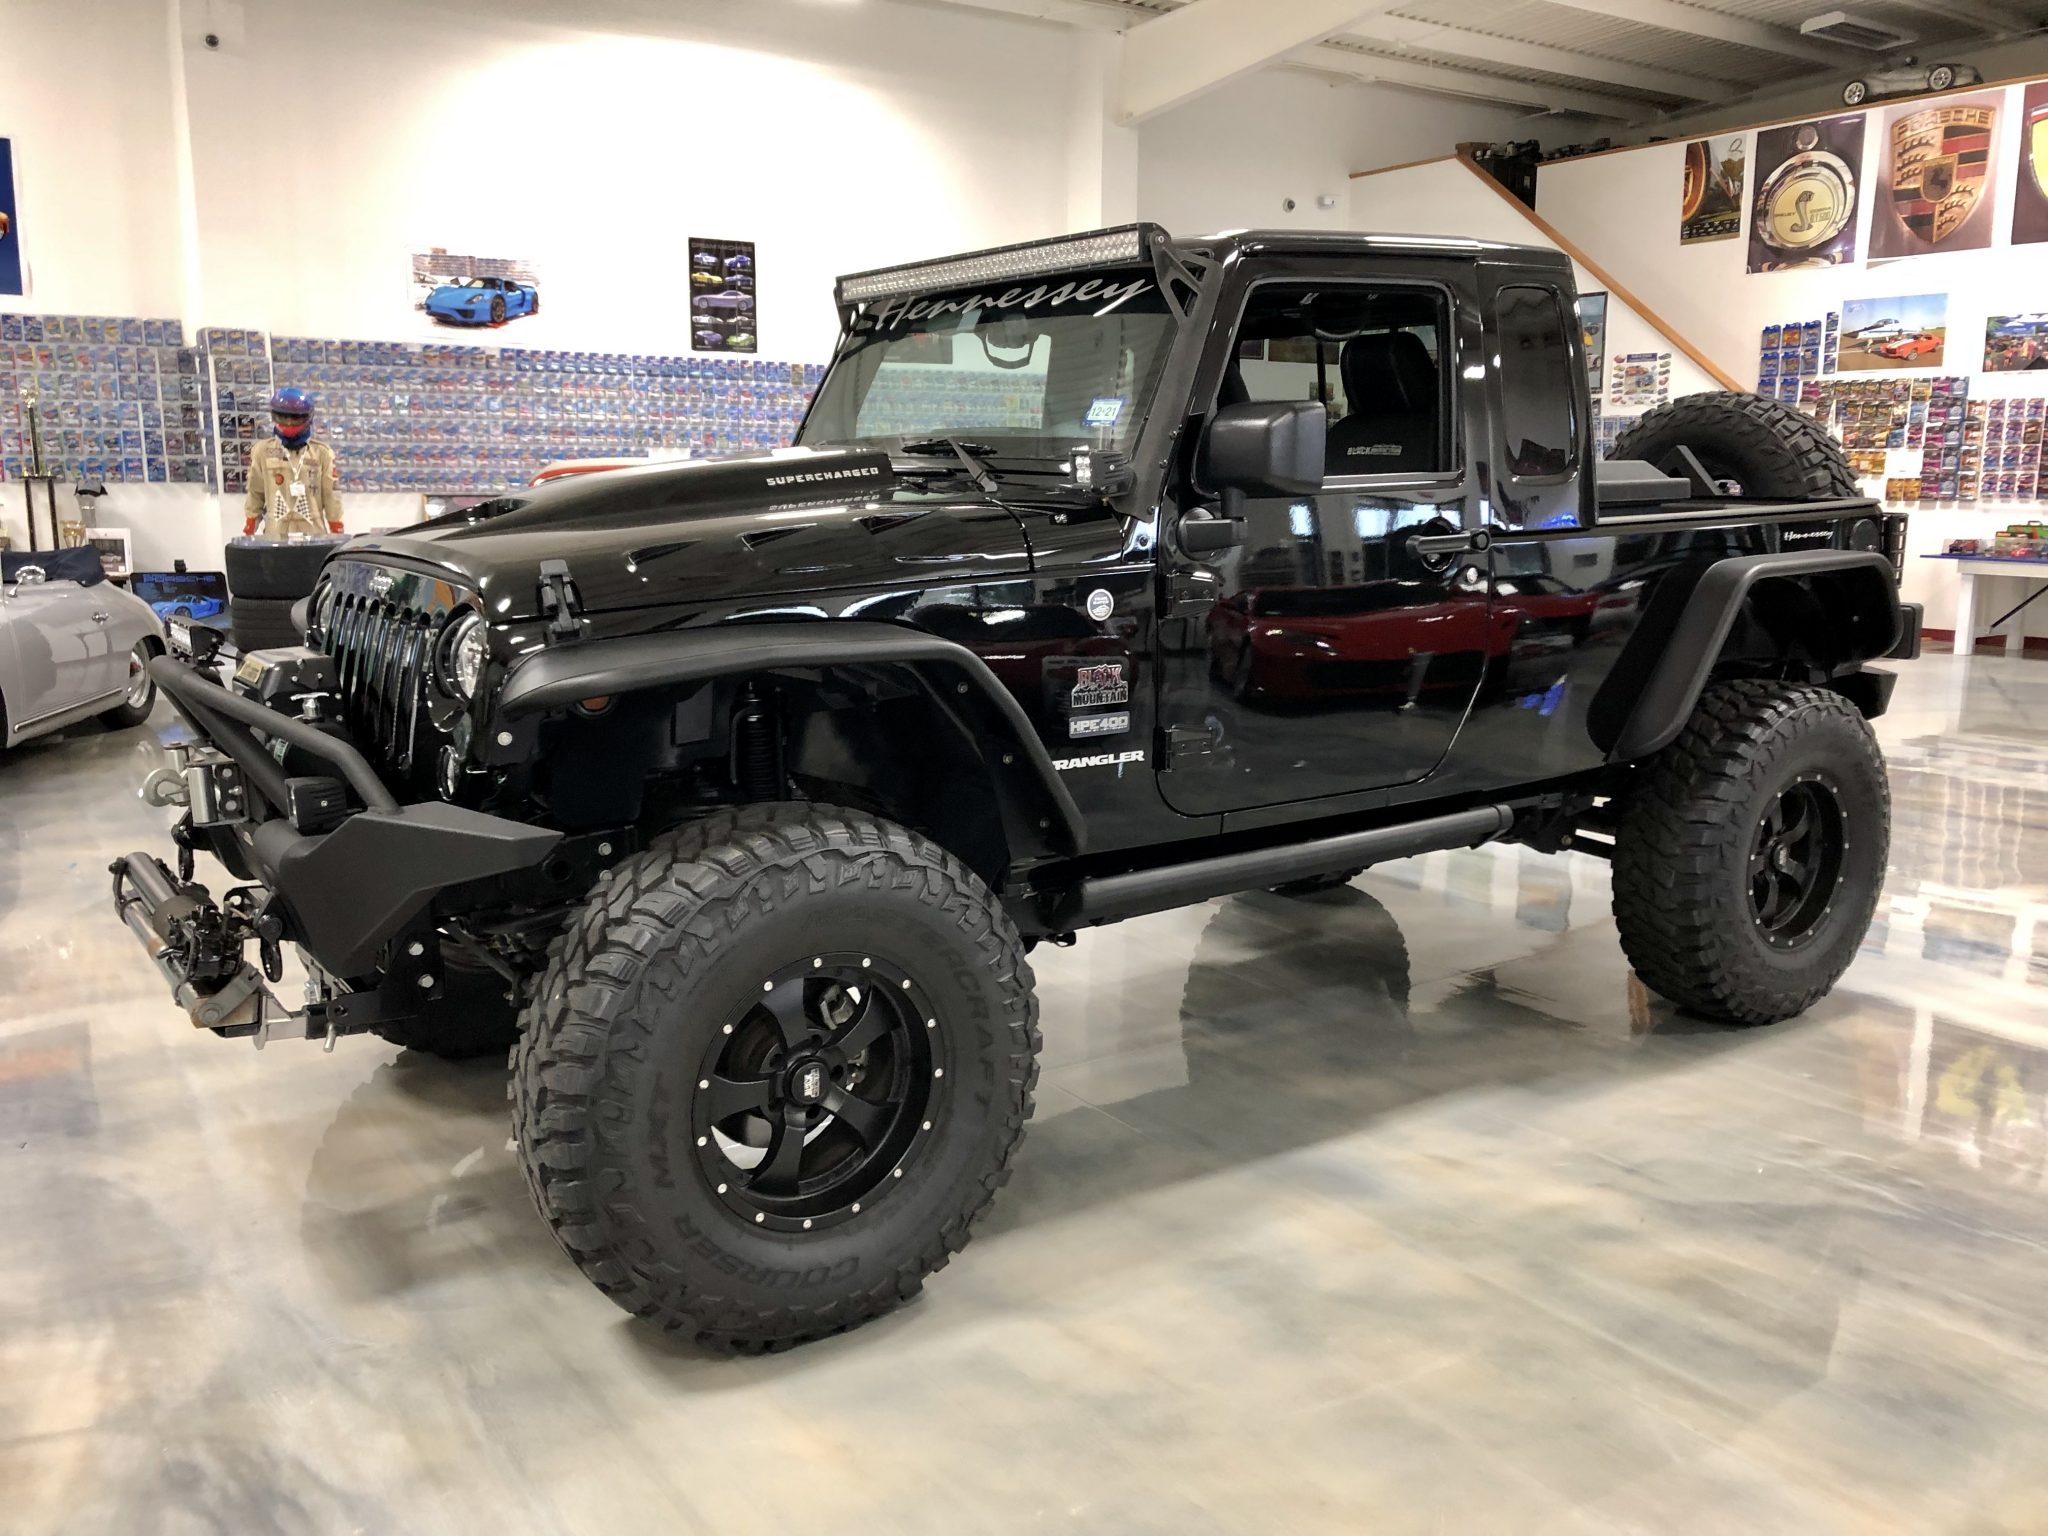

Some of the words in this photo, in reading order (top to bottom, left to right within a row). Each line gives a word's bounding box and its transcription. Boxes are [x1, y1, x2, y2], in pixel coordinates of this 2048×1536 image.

[1893, 108, 1990, 138] PORSCHE
[875, 279, 1154, 330] Hennessey
[766, 467, 879, 486] SUPERCHARGED
[1074, 687, 1127, 705] MOUNTAIN
[1070, 716, 1128, 734] HPE400
[1052, 750, 1145, 770] RANGLER
